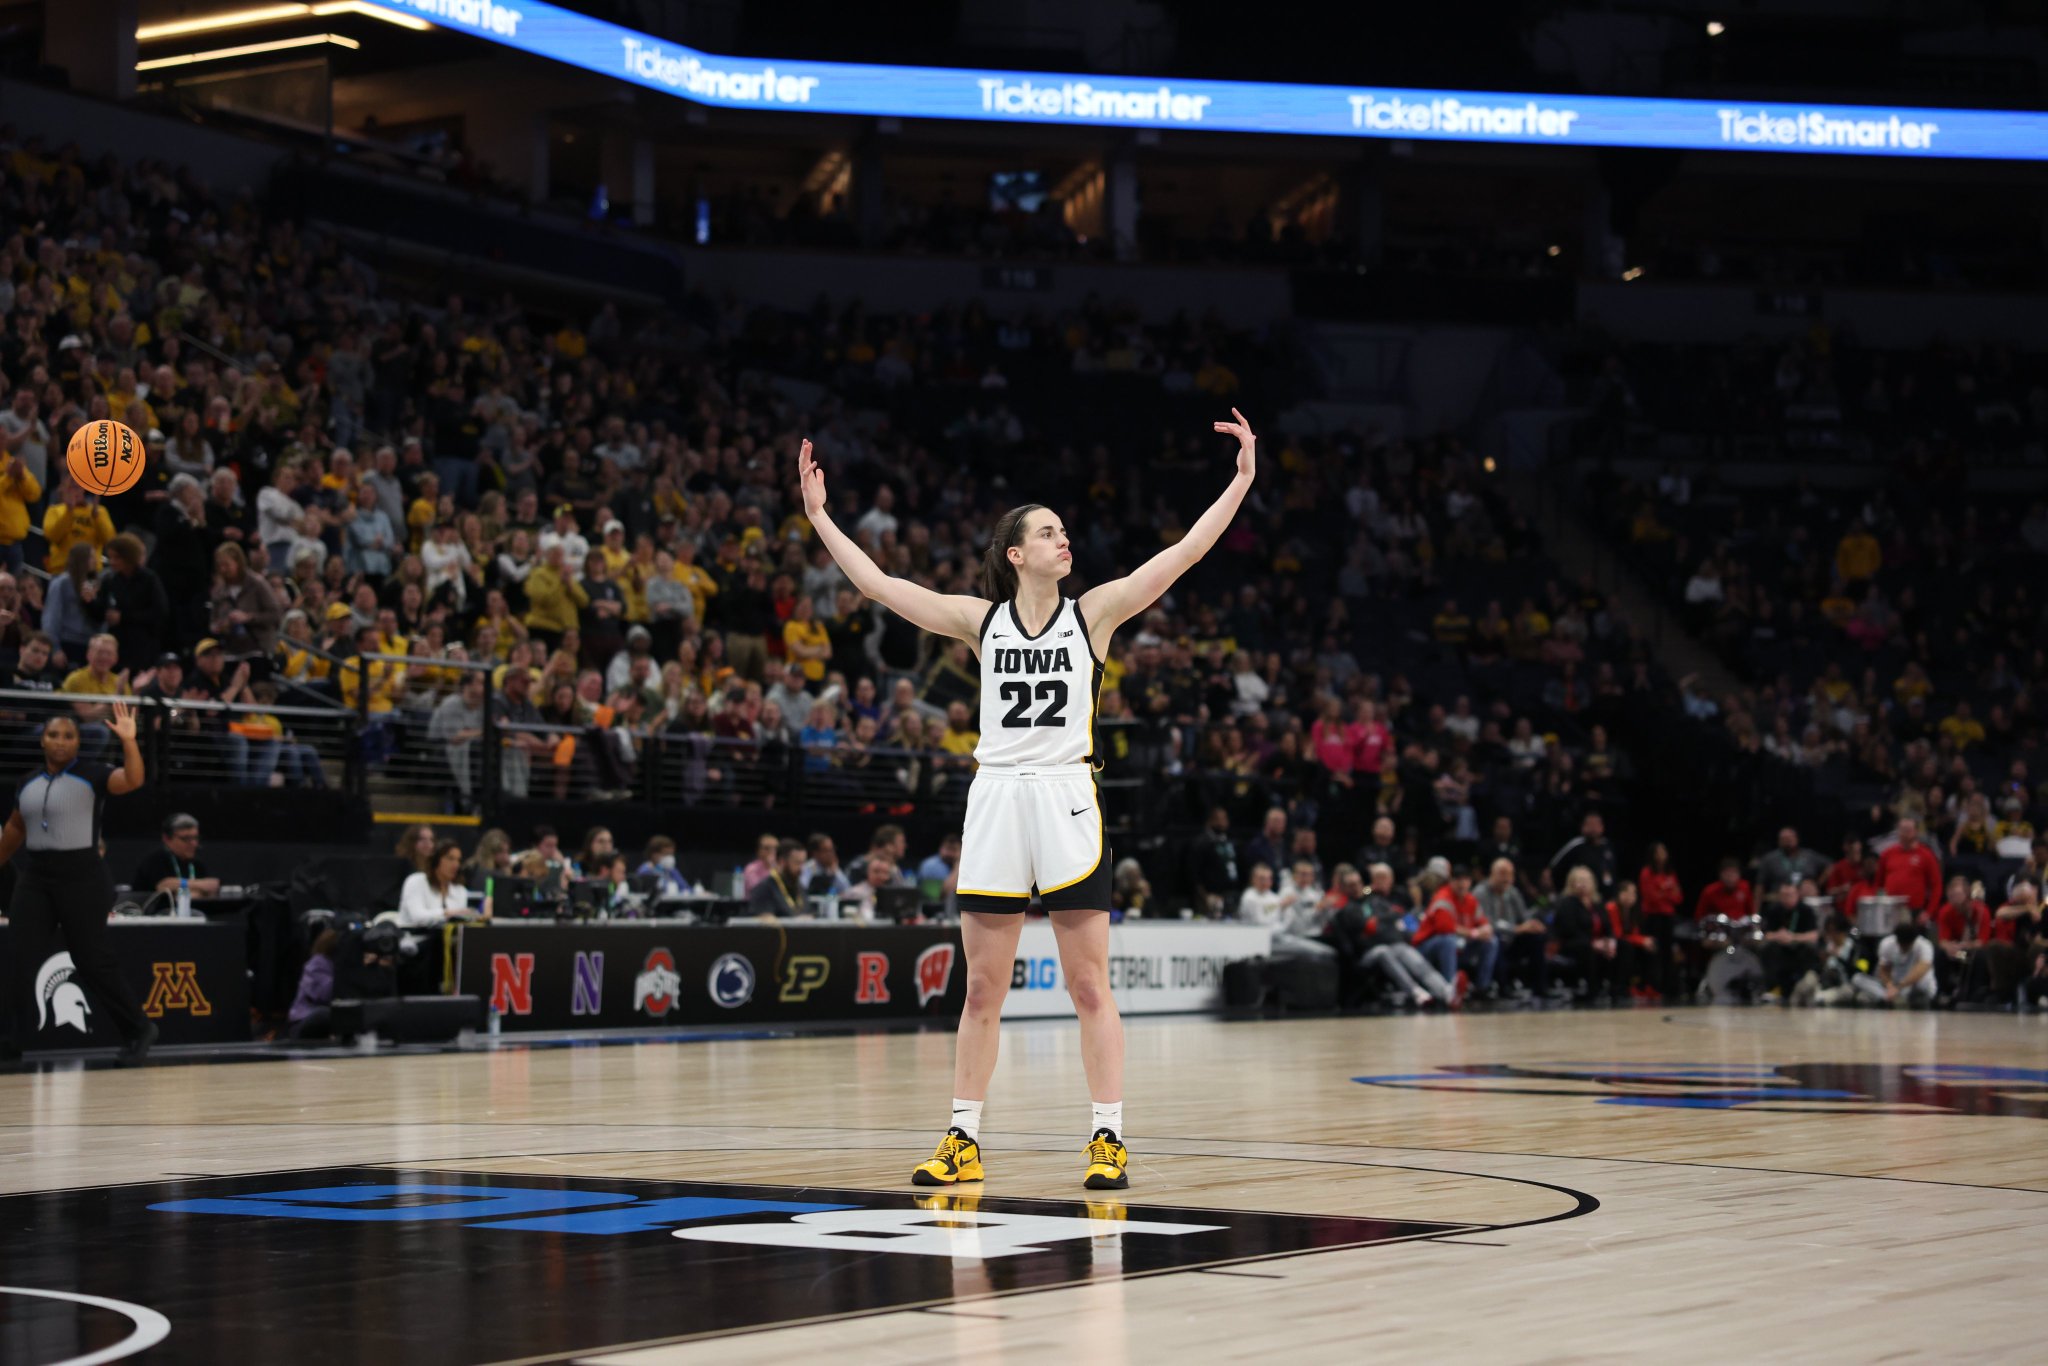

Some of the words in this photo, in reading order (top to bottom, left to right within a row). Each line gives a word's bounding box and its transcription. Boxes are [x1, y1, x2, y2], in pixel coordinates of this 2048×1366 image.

[621, 36, 820, 103] TicketSmarter
[977, 78, 1212, 122] TicketSmarter
[1348, 94, 1579, 137] TicketSmarter
[1716, 108, 1940, 149] TicketSmarter
[94, 422, 109, 468] Wilson
[120, 428, 133, 464] NCAA
[993, 647, 1073, 674] IOWA
[999, 680, 1069, 728] 22
[142, 962, 212, 1017] M
[489, 953, 535, 1016] N
[571, 951, 604, 1015] N
[779, 955, 831, 1002] P
[855, 952, 891, 1004] R
